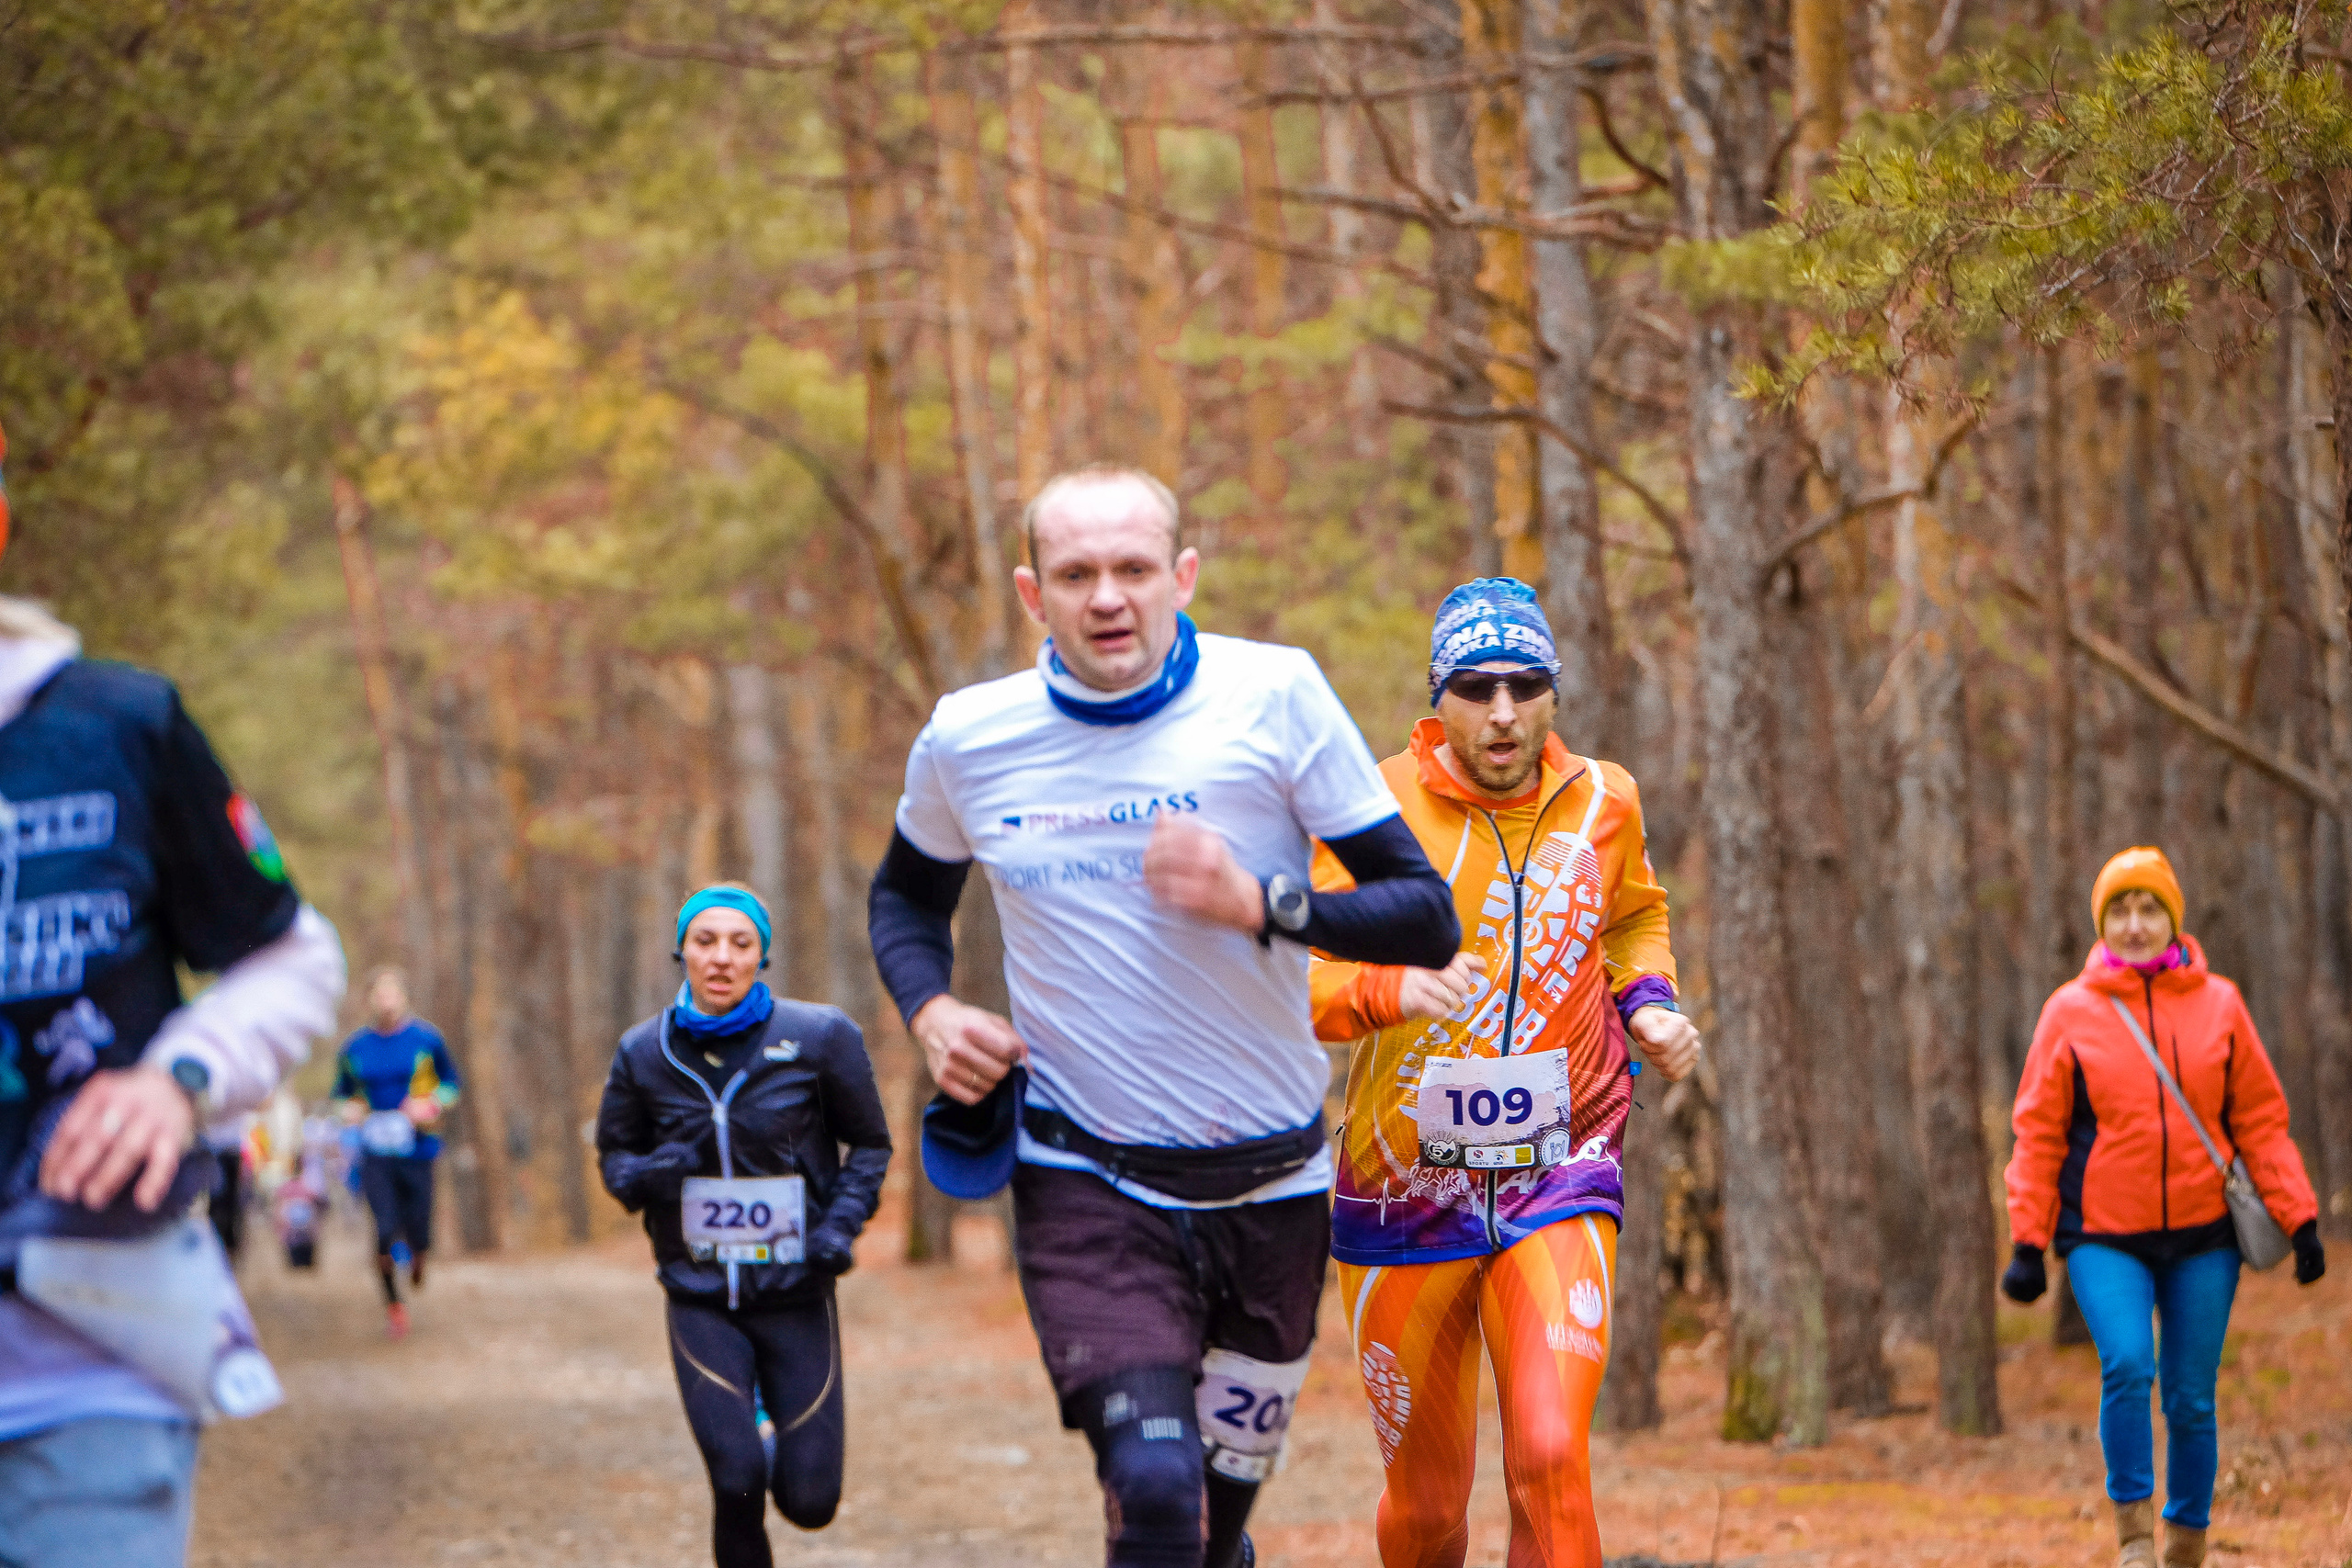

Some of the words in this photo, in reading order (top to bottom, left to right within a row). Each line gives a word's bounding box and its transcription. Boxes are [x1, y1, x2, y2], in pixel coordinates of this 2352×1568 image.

[1027, 792, 1199, 834] PRESSGLASS
[1062, 855, 1113, 884] AND
[1445, 1087, 1533, 1126] 109
[702, 1199, 772, 1229] 220
